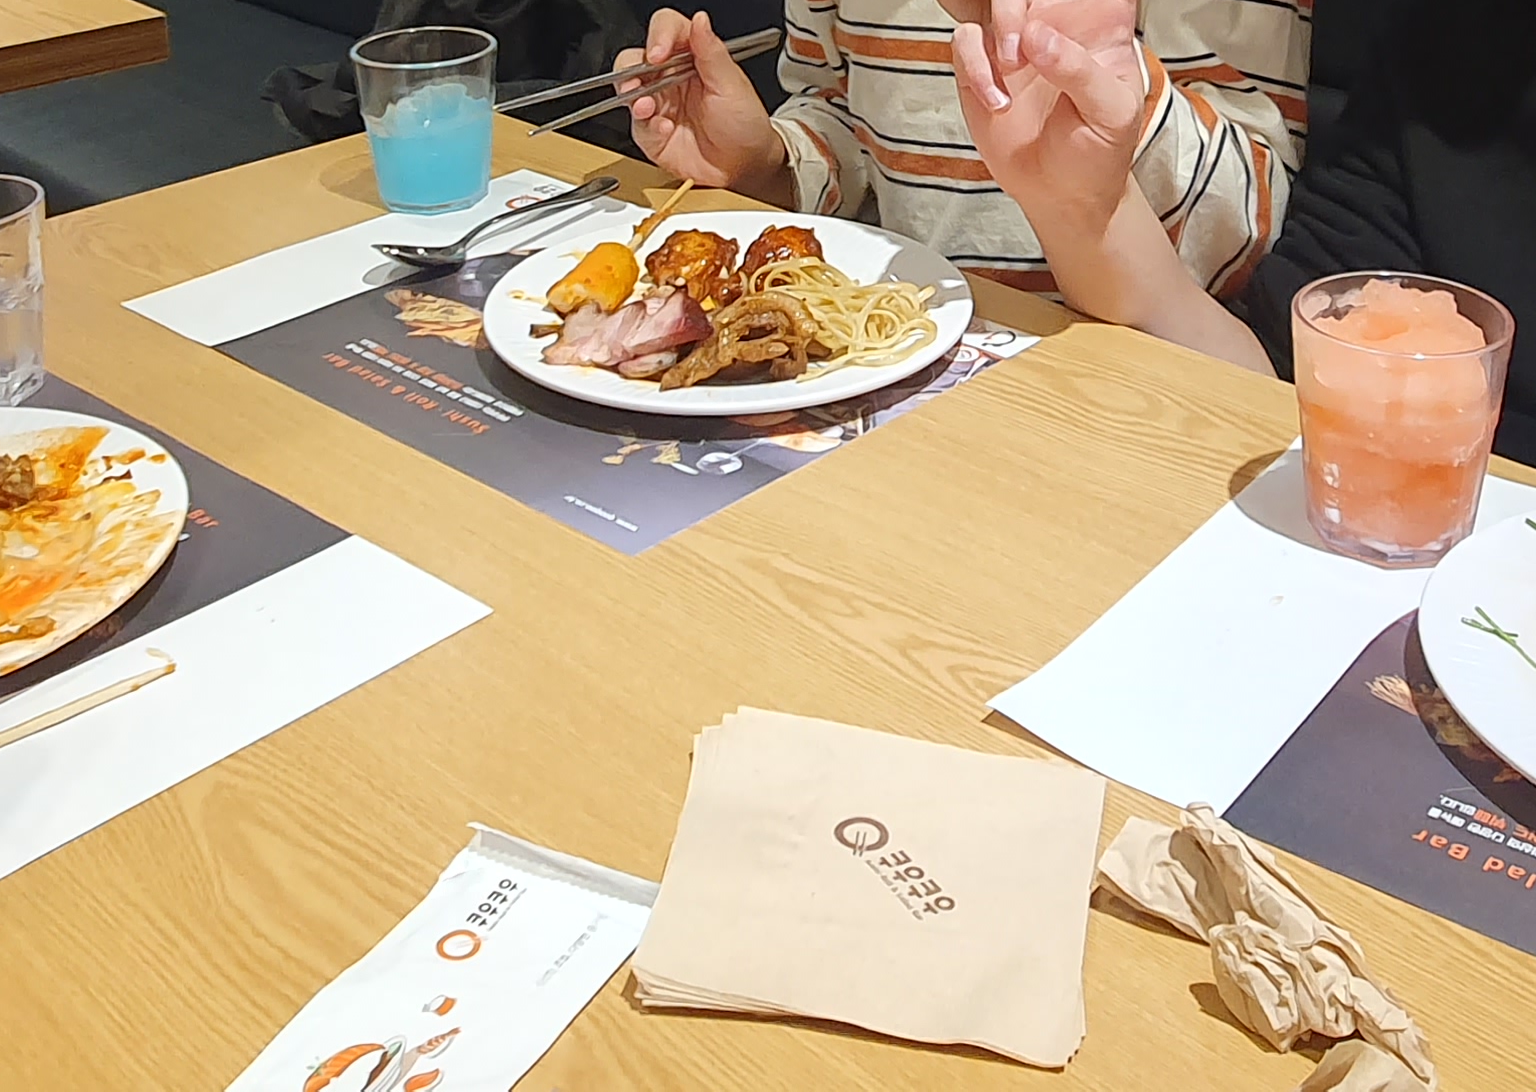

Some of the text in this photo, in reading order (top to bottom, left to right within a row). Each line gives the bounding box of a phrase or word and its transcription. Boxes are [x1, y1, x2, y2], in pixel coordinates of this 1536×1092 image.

[1412, 829, 1470, 862] Bar
[466, 879, 520, 926] 쿠우쿠우
[879, 850, 957, 915] 쿠우쿠우
